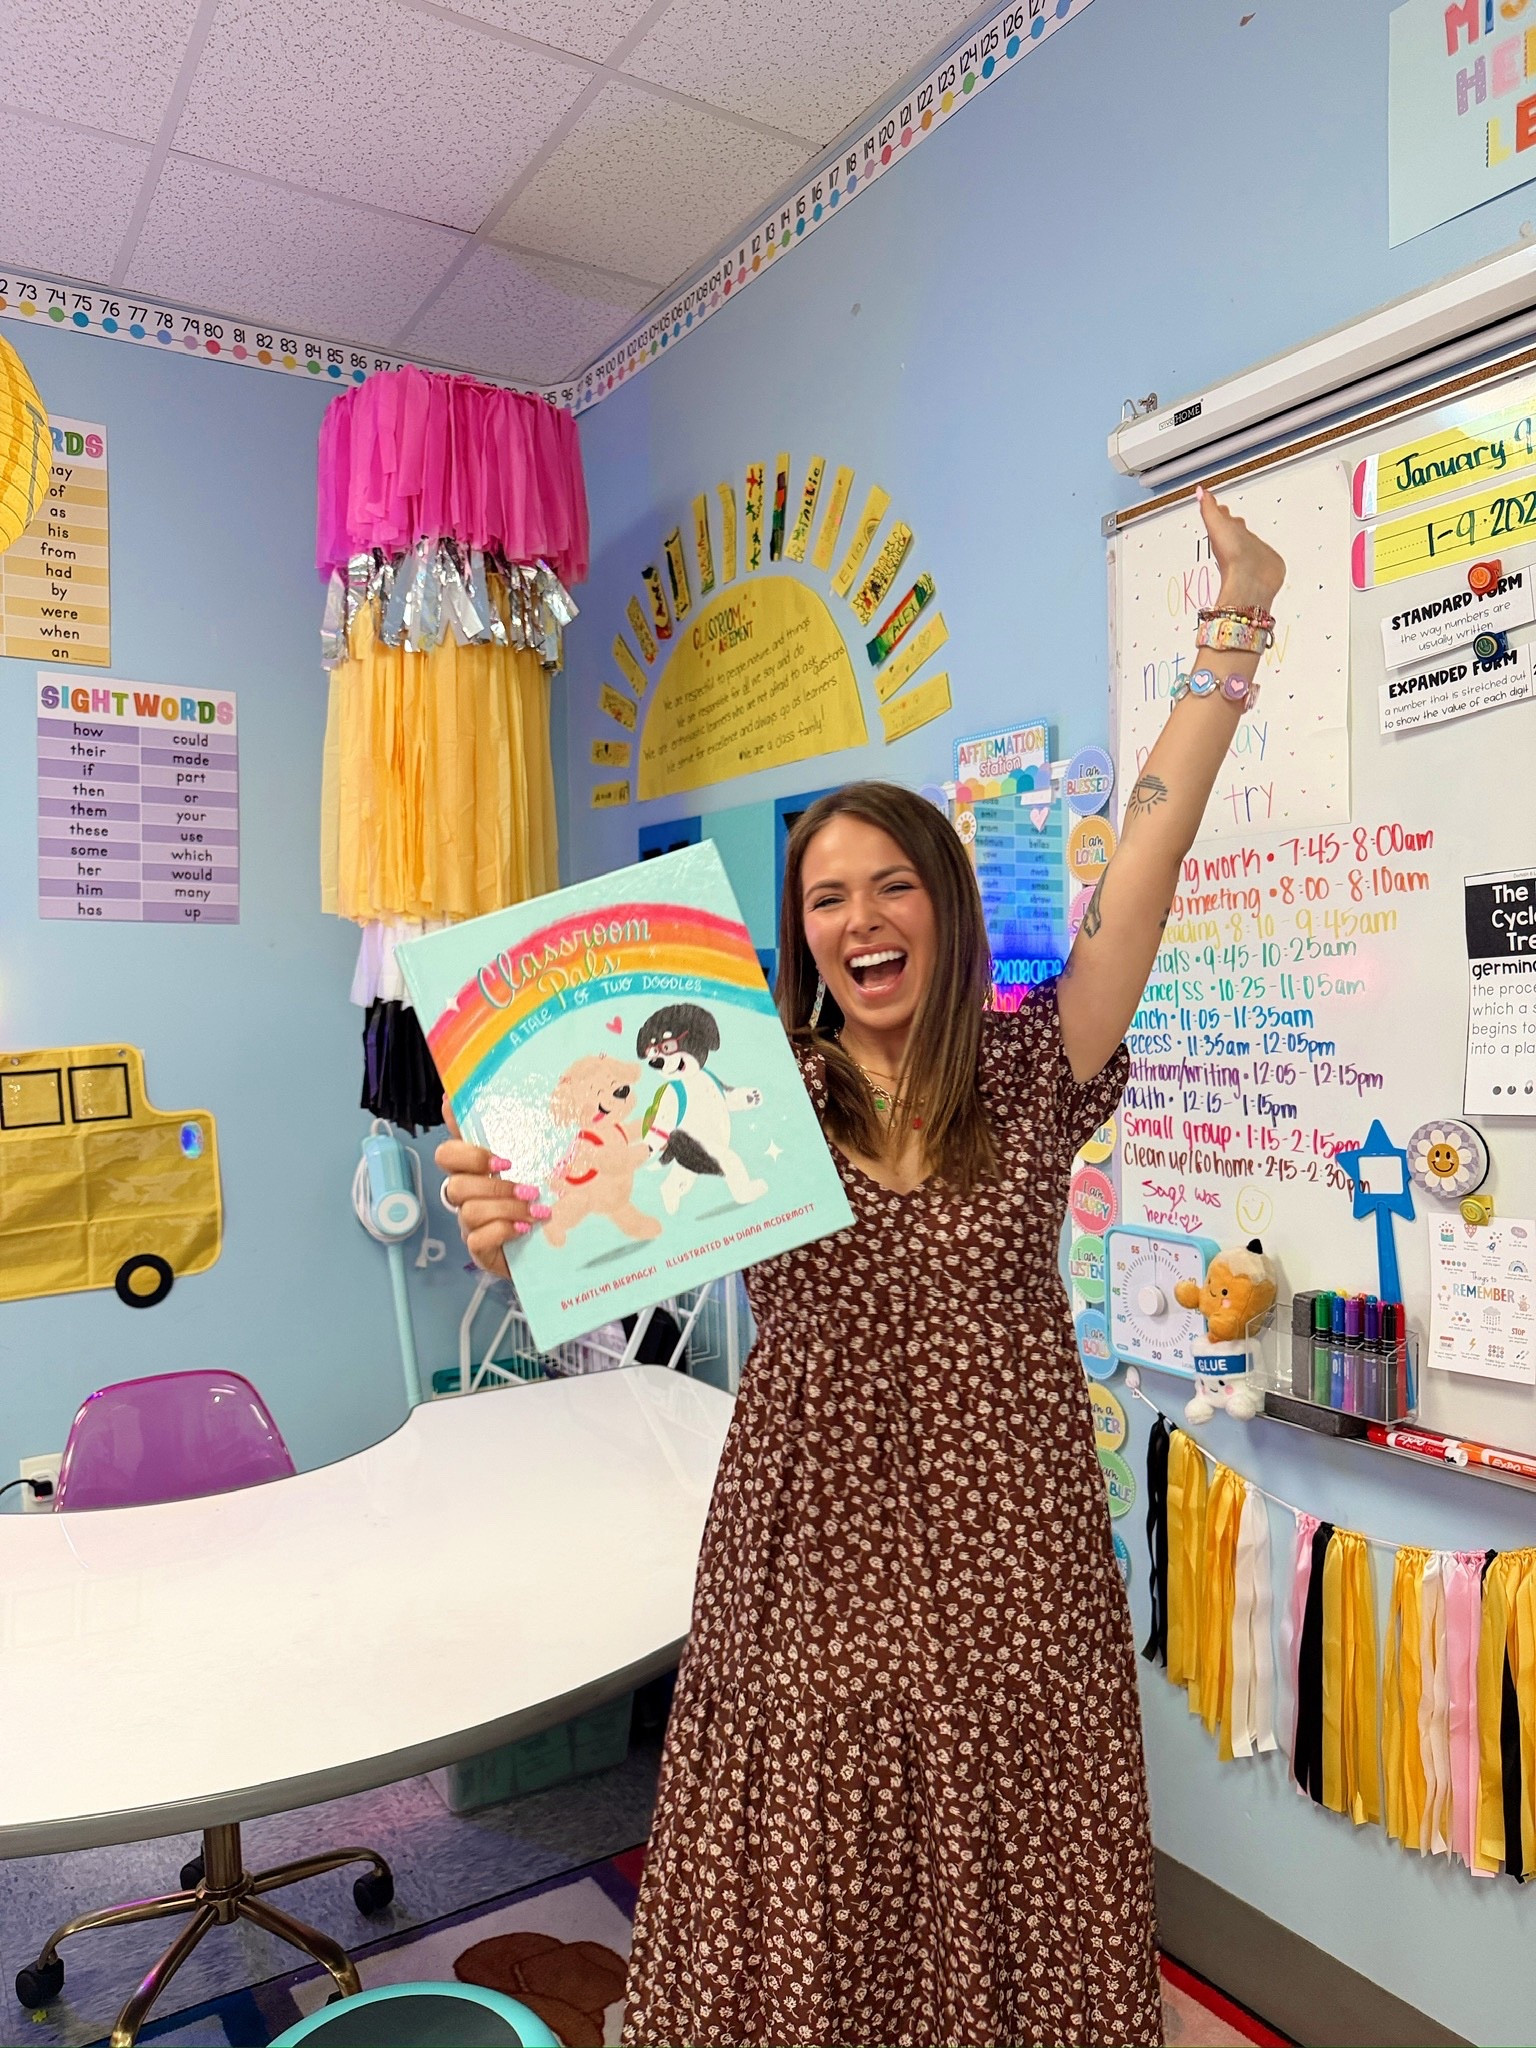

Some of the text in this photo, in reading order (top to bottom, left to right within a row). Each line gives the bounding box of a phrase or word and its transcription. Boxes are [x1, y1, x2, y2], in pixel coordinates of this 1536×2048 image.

[878, 120, 895, 147] 120
[917, 85, 934, 113] 122
[959, 44, 978, 75] 124
[1003, 6, 1023, 40] 126
[16, 282, 368, 369] 73 75 77 79 80 82 84 86
[49, 426, 104, 459] RDS
[1395, 439, 1507, 492] January
[49, 484, 66, 498] of
[50, 507, 66, 519] as
[48, 524, 69, 539] his
[40, 542, 77, 560] from
[45, 563, 72, 579] had
[51, 583, 68, 601] by
[41, 606, 78, 620] were
[1391, 591, 1473, 631] STANDARD
[1400, 601, 1511, 645] the way numbers are
[39, 625, 80, 641] when
[1418, 620, 1494, 652] usually written
[51, 648, 69, 659] an
[1388, 664, 1468, 699] EXPANDED
[1393, 670, 1526, 715] number that stretched out
[40, 685, 234, 726] SIGHT WORDS
[1384, 685, 1530, 730] to show the value of each digit
[73, 722, 104, 738] how
[172, 734, 209, 748] could
[958, 727, 1045, 766] AFFIRMATION
[70, 744, 107, 758] their
[172, 753, 210, 767] made
[979, 754, 1022, 778] station
[82, 763, 96, 776] if
[1085, 767, 1101, 776] am
[176, 772, 206, 787] part
[1066, 776, 1109, 796] BLESSED
[72, 783, 105, 798] then
[184, 793, 199, 803] or
[70, 803, 108, 818] them
[176, 811, 207, 825] your
[69, 823, 109, 838] these
[180, 832, 203, 843] use
[1088, 836, 1104, 846] am
[70, 846, 109, 857] some
[171, 849, 213, 862] which
[1075, 847, 1107, 866] LOYAL
[77, 862, 102, 876] her
[1204, 847, 1261, 881] work
[171, 869, 213, 881] would
[76, 882, 104, 896] him
[174, 889, 211, 902] many
[1186, 887, 1261, 919] meeting
[1279, 875, 1330, 906] 8:00
[1347, 865, 1430, 903] 8:10am
[1491, 884, 1529, 905] The
[77, 903, 103, 916] has
[184, 907, 201, 922] up
[477, 917, 652, 1010] Classroom
[537, 949, 621, 1010] Pals
[1472, 983, 1495, 997] the
[508, 1031, 522, 1049] A
[600, 976, 633, 996] TWO
[1472, 1001, 1514, 1017] which
[1130, 1007, 1168, 1030] unch
[1472, 1021, 1536, 1039] begins to
[1470, 1042, 1511, 1056] into a
[1123, 1085, 1166, 1111] math
[1124, 1111, 1173, 1140] Small
[1182, 1120, 1232, 1153] group
[1124, 1142, 1166, 1169] Clean
[1074, 1191, 1110, 1221] HAPPY
[560, 1203, 816, 1311] BY KAITLYN BIERNACKI ILLUSTRATED BY DIANA MCDERMOTT
[1131, 1245, 1140, 1254] 55
[1070, 1260, 1105, 1280] LISTEN
[1116, 1261, 1126, 1271] 50
[1112, 1287, 1121, 1296] 45
[1453, 1282, 1516, 1304] REMEMBER
[1117, 1314, 1126, 1323] 40
[1511, 1327, 1526, 1336] STOP
[1131, 1338, 1141, 1348] 35
[1151, 1350, 1162, 1360] 30
[1173, 1349, 1183, 1359] 25
[1197, 1358, 1228, 1372] GLUE
[1491, 1457, 1521, 1472] EXPO
